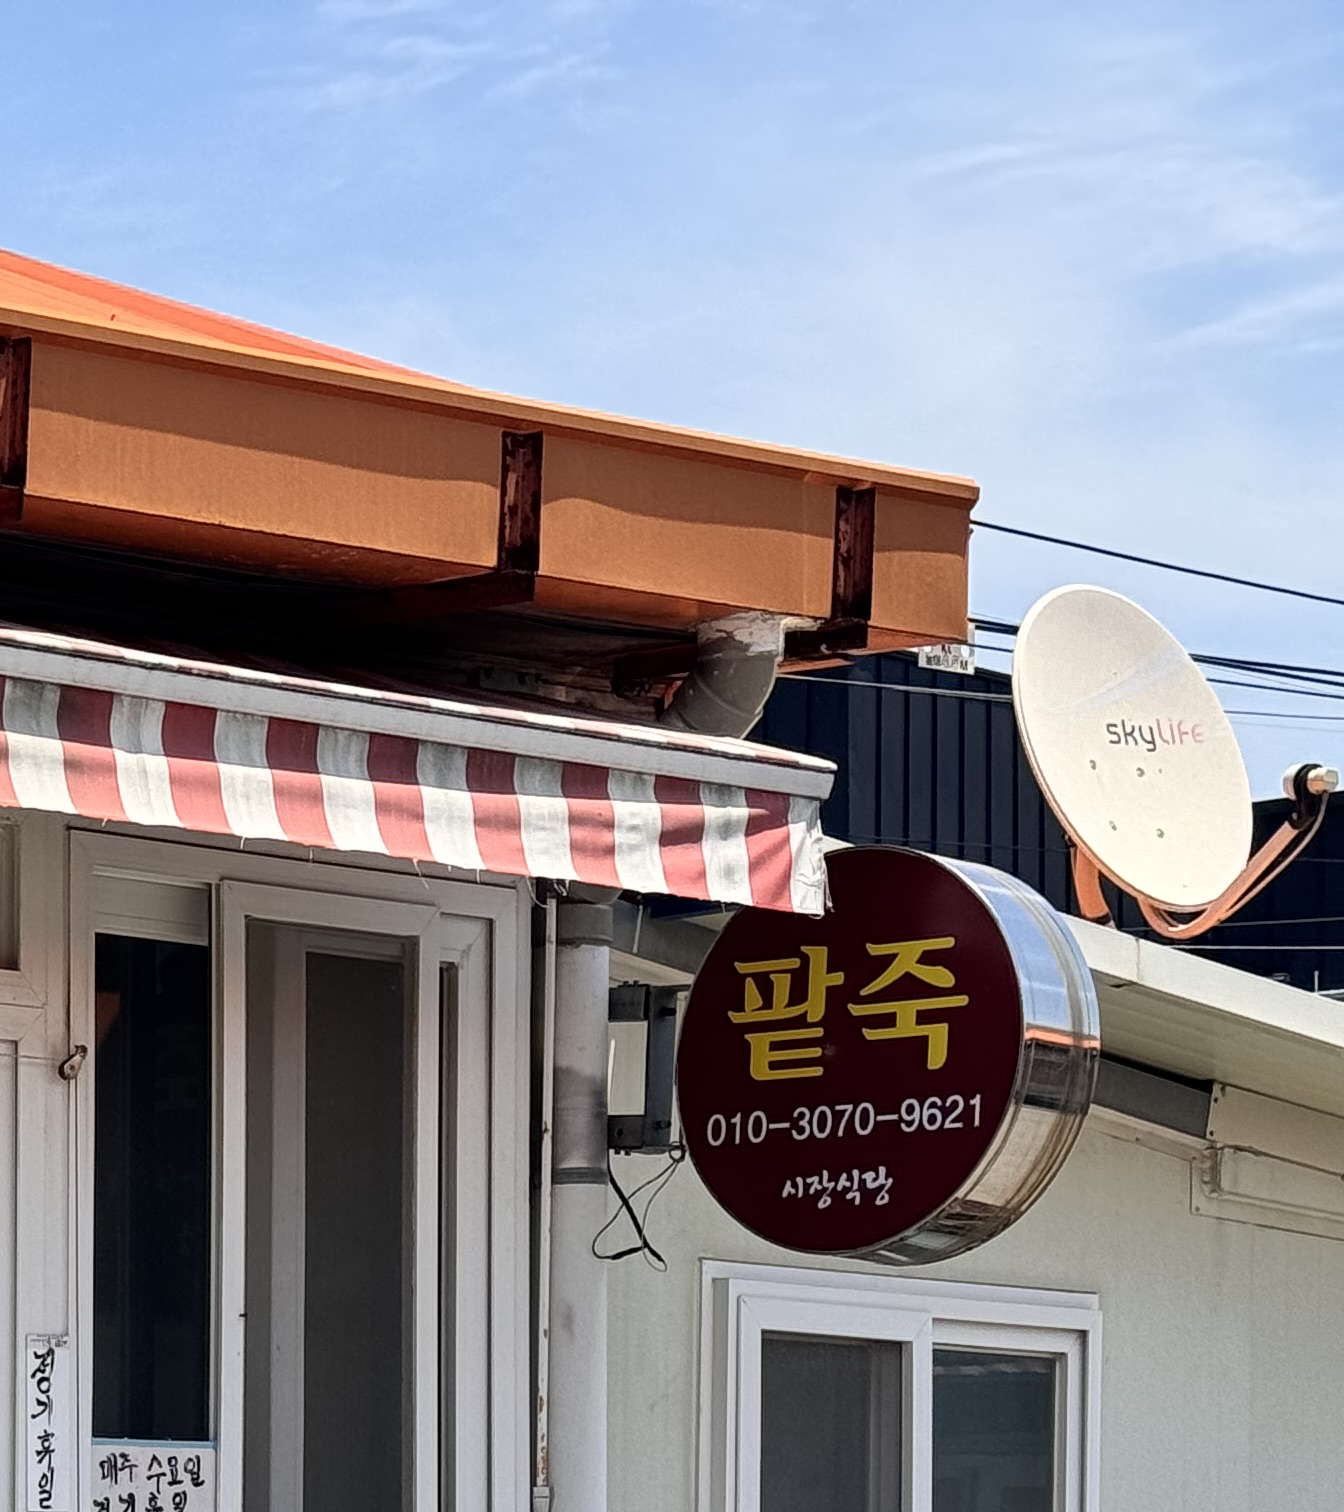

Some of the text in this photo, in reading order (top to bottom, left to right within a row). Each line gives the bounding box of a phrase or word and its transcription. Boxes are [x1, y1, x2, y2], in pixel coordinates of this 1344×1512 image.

[727, 936, 969, 1081] 팥죽
[706, 1093, 982, 1146] 010-3070-9621
[782, 1166, 893, 1209] 시장식당
[99, 1452, 205, 1496] 매주 수요일
